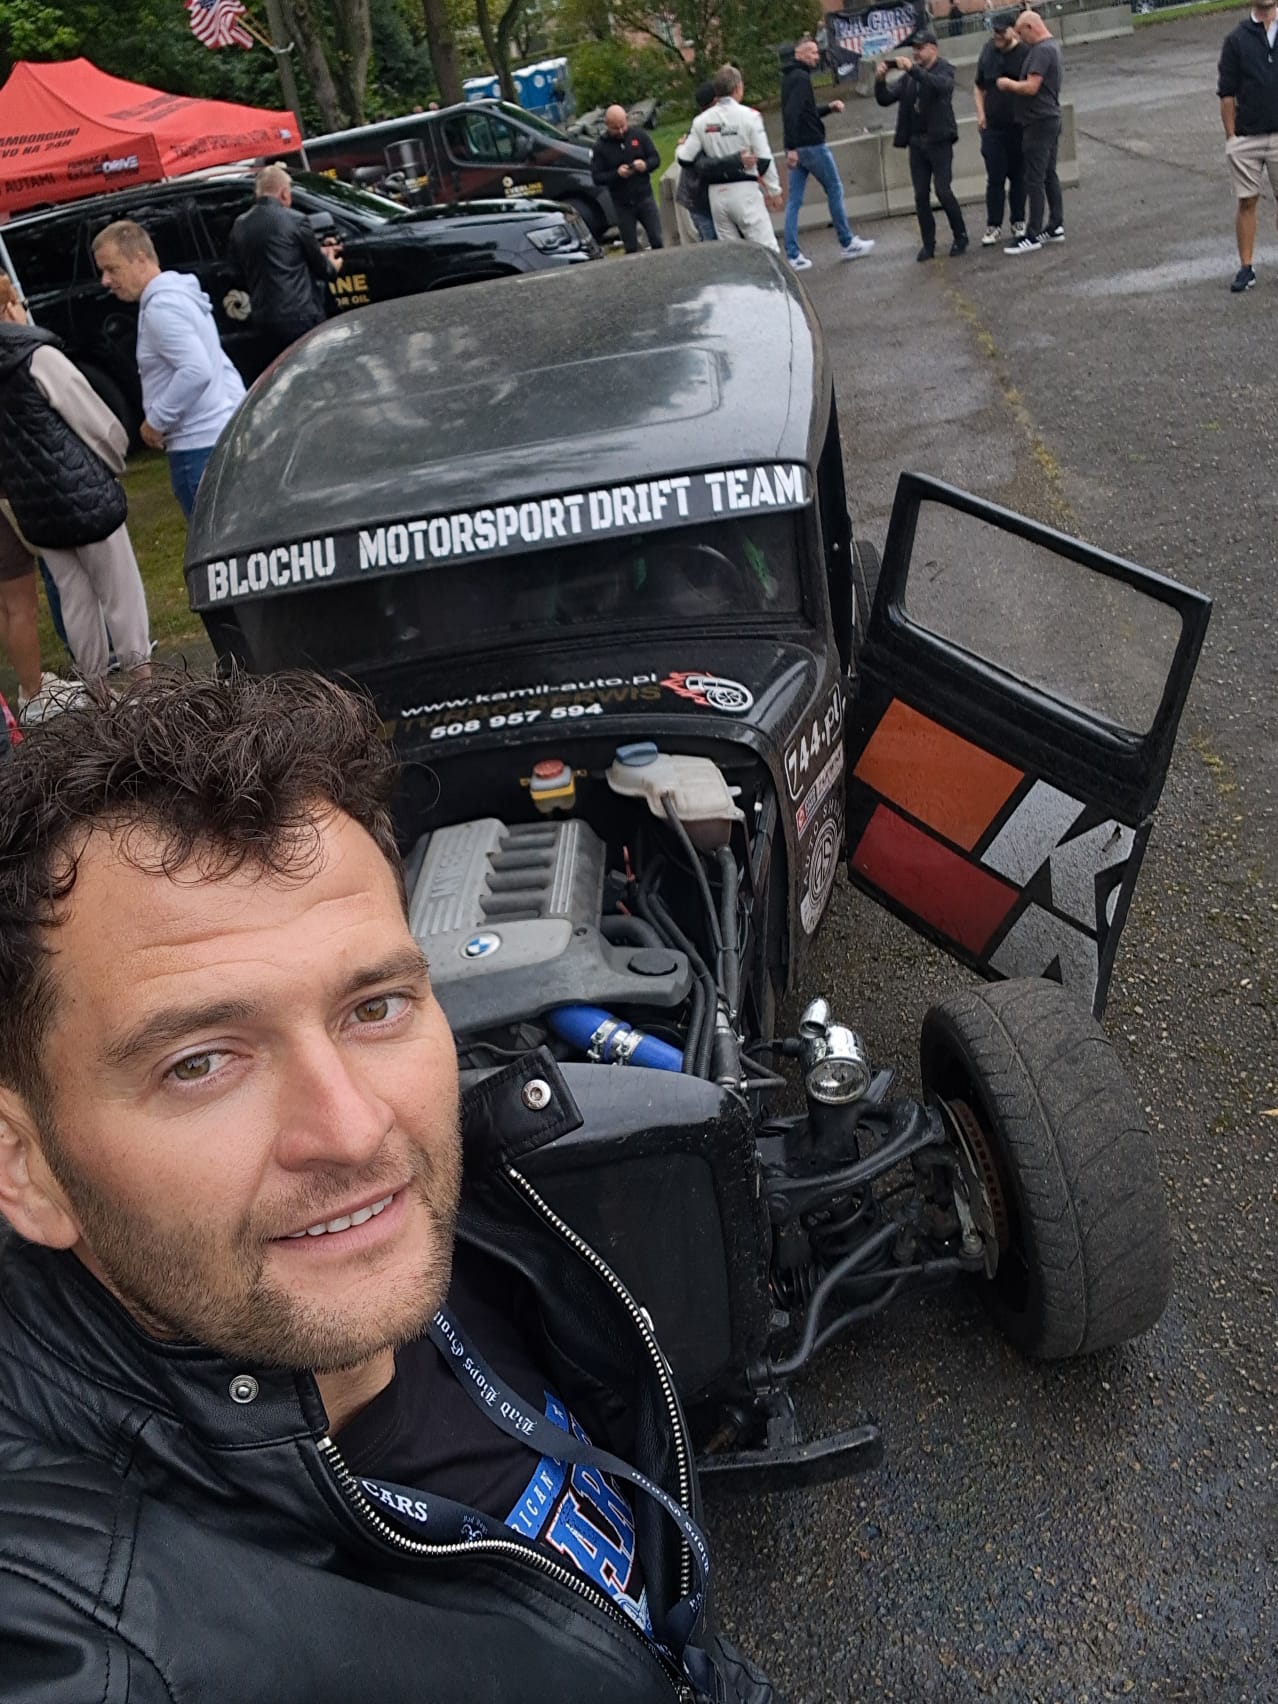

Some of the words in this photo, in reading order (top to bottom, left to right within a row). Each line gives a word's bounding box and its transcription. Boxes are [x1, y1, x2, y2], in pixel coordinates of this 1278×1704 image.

[207, 537, 336, 601] BLOCHU
[358, 495, 586, 570] MOTORSPORT
[587, 477, 691, 531] DRIFT
[704, 465, 805, 512] TEAM
[401, 673, 657, 718] www.kamil-auto.pl
[429, 719, 481, 739] 508
[489, 709, 542, 729] 957
[550, 702, 603, 719] 594
[433, 1311, 464, 1356] Grou
[463, 1357, 500, 1407] Boys
[500, 1401, 538, 1436] Bad
[361, 1480, 428, 1522] CARS
